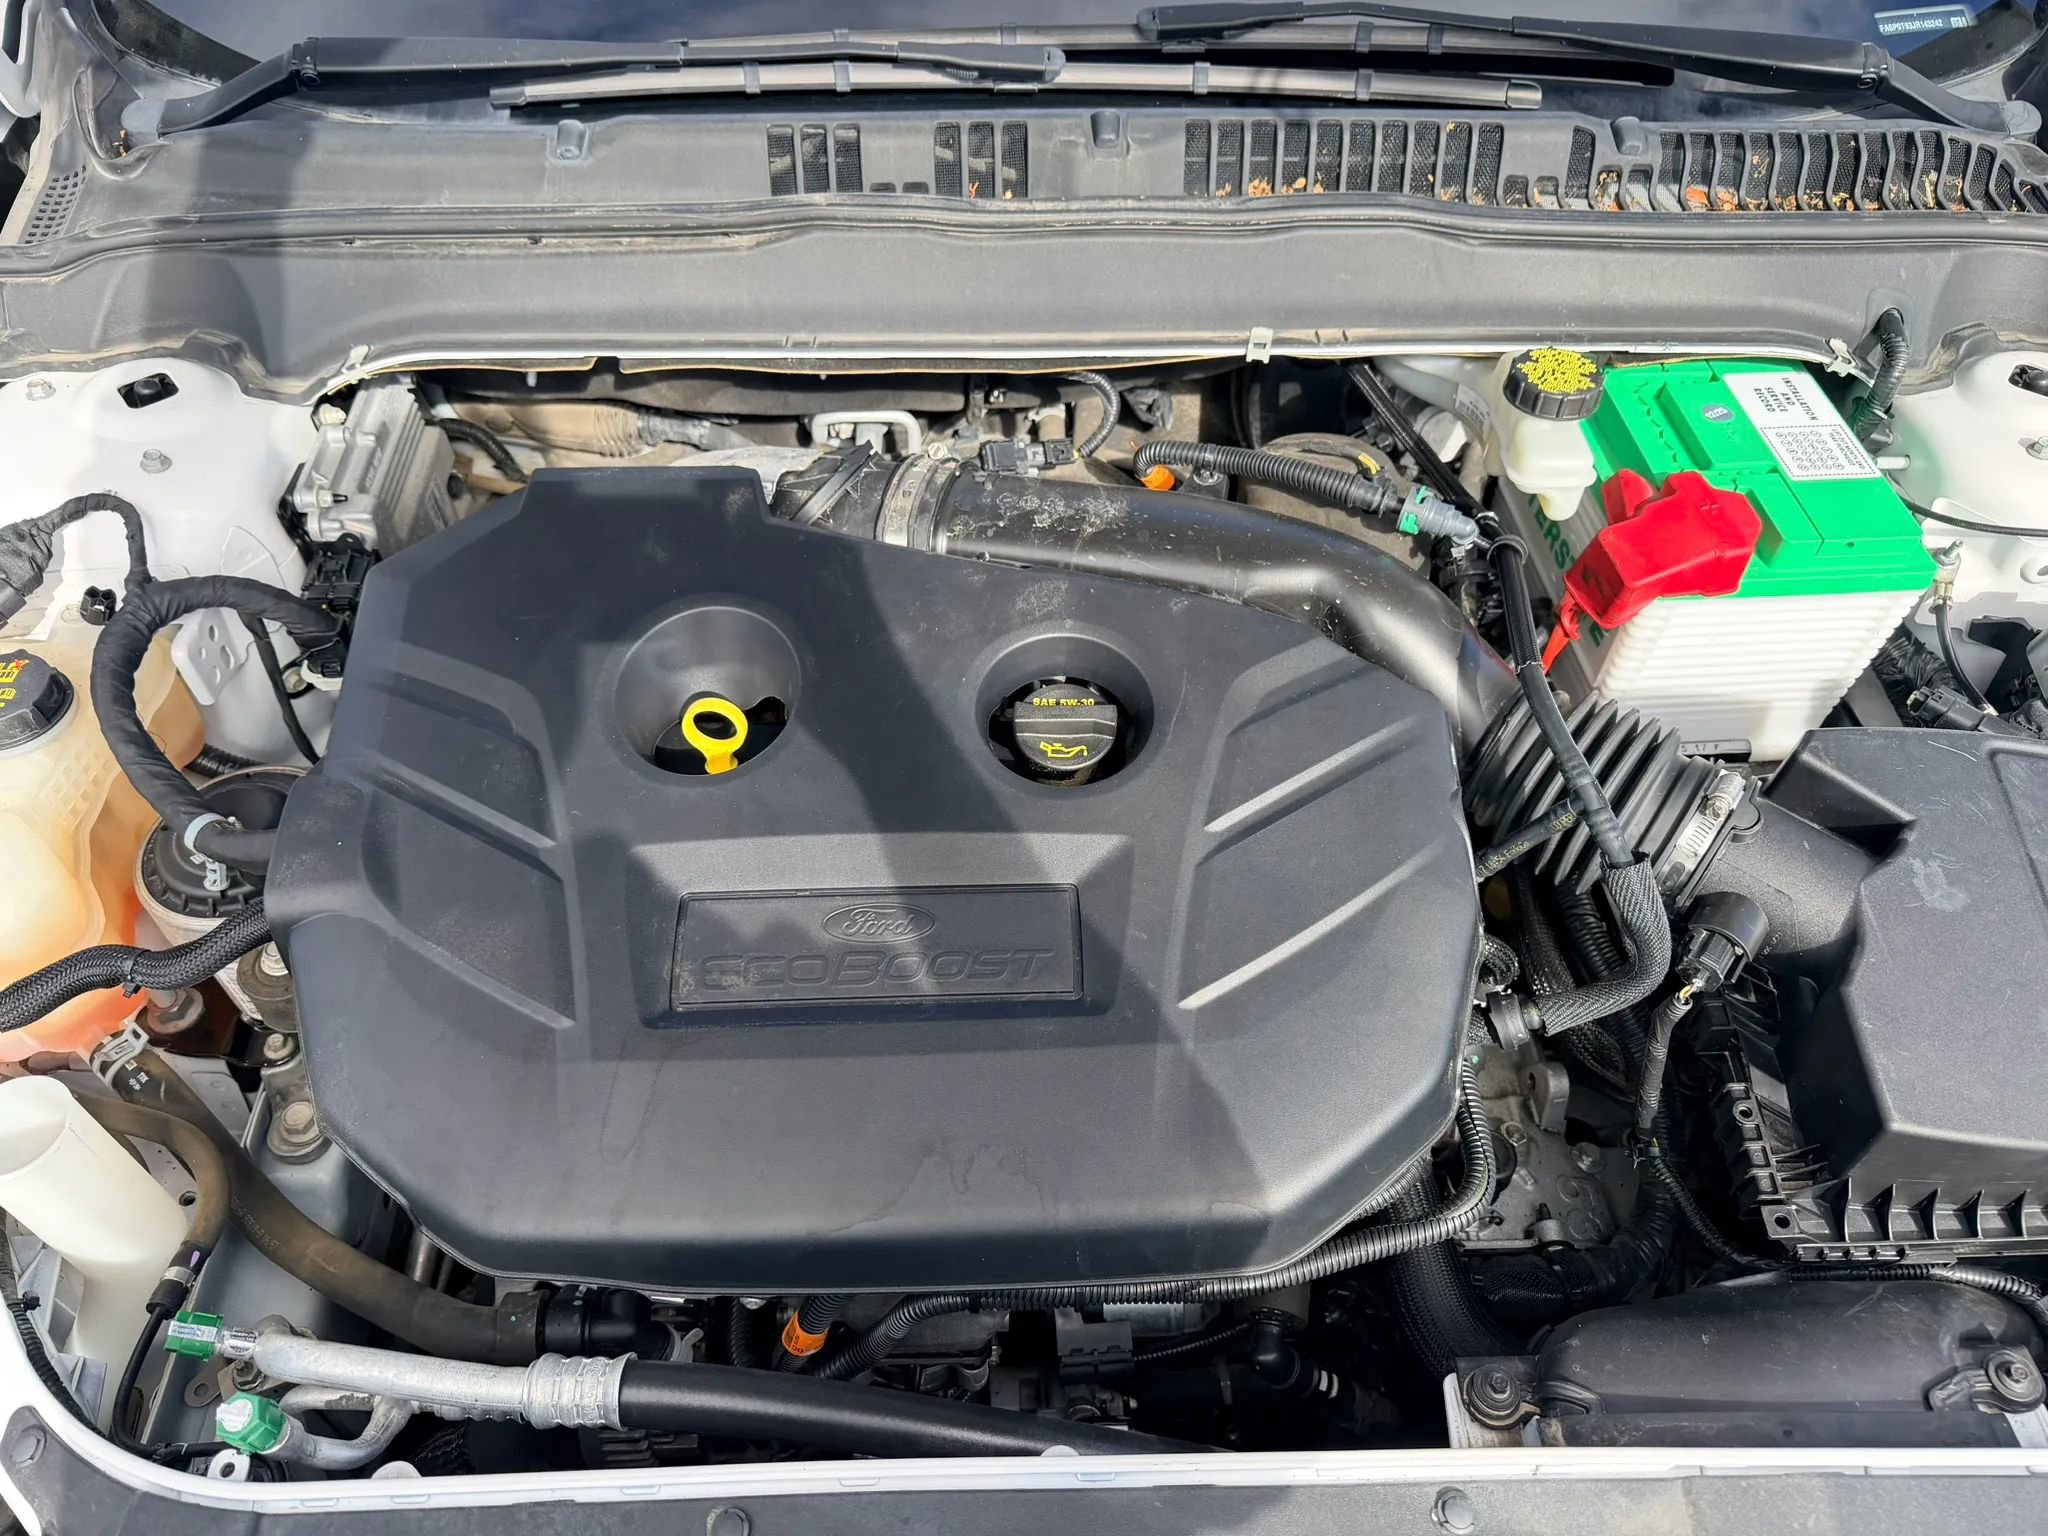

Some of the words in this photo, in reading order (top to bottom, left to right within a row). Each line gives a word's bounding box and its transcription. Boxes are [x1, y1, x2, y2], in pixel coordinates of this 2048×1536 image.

[1753, 387, 1776, 413] RECORD
[1764, 387, 1789, 413] SERVICE
[1779, 391, 1796, 407] AND
[1781, 377, 1819, 421] INSTALLATION
[1032, 697, 1057, 707] SAE
[1059, 698, 1095, 707] 5W-30
[838, 907, 917, 937] Ford
